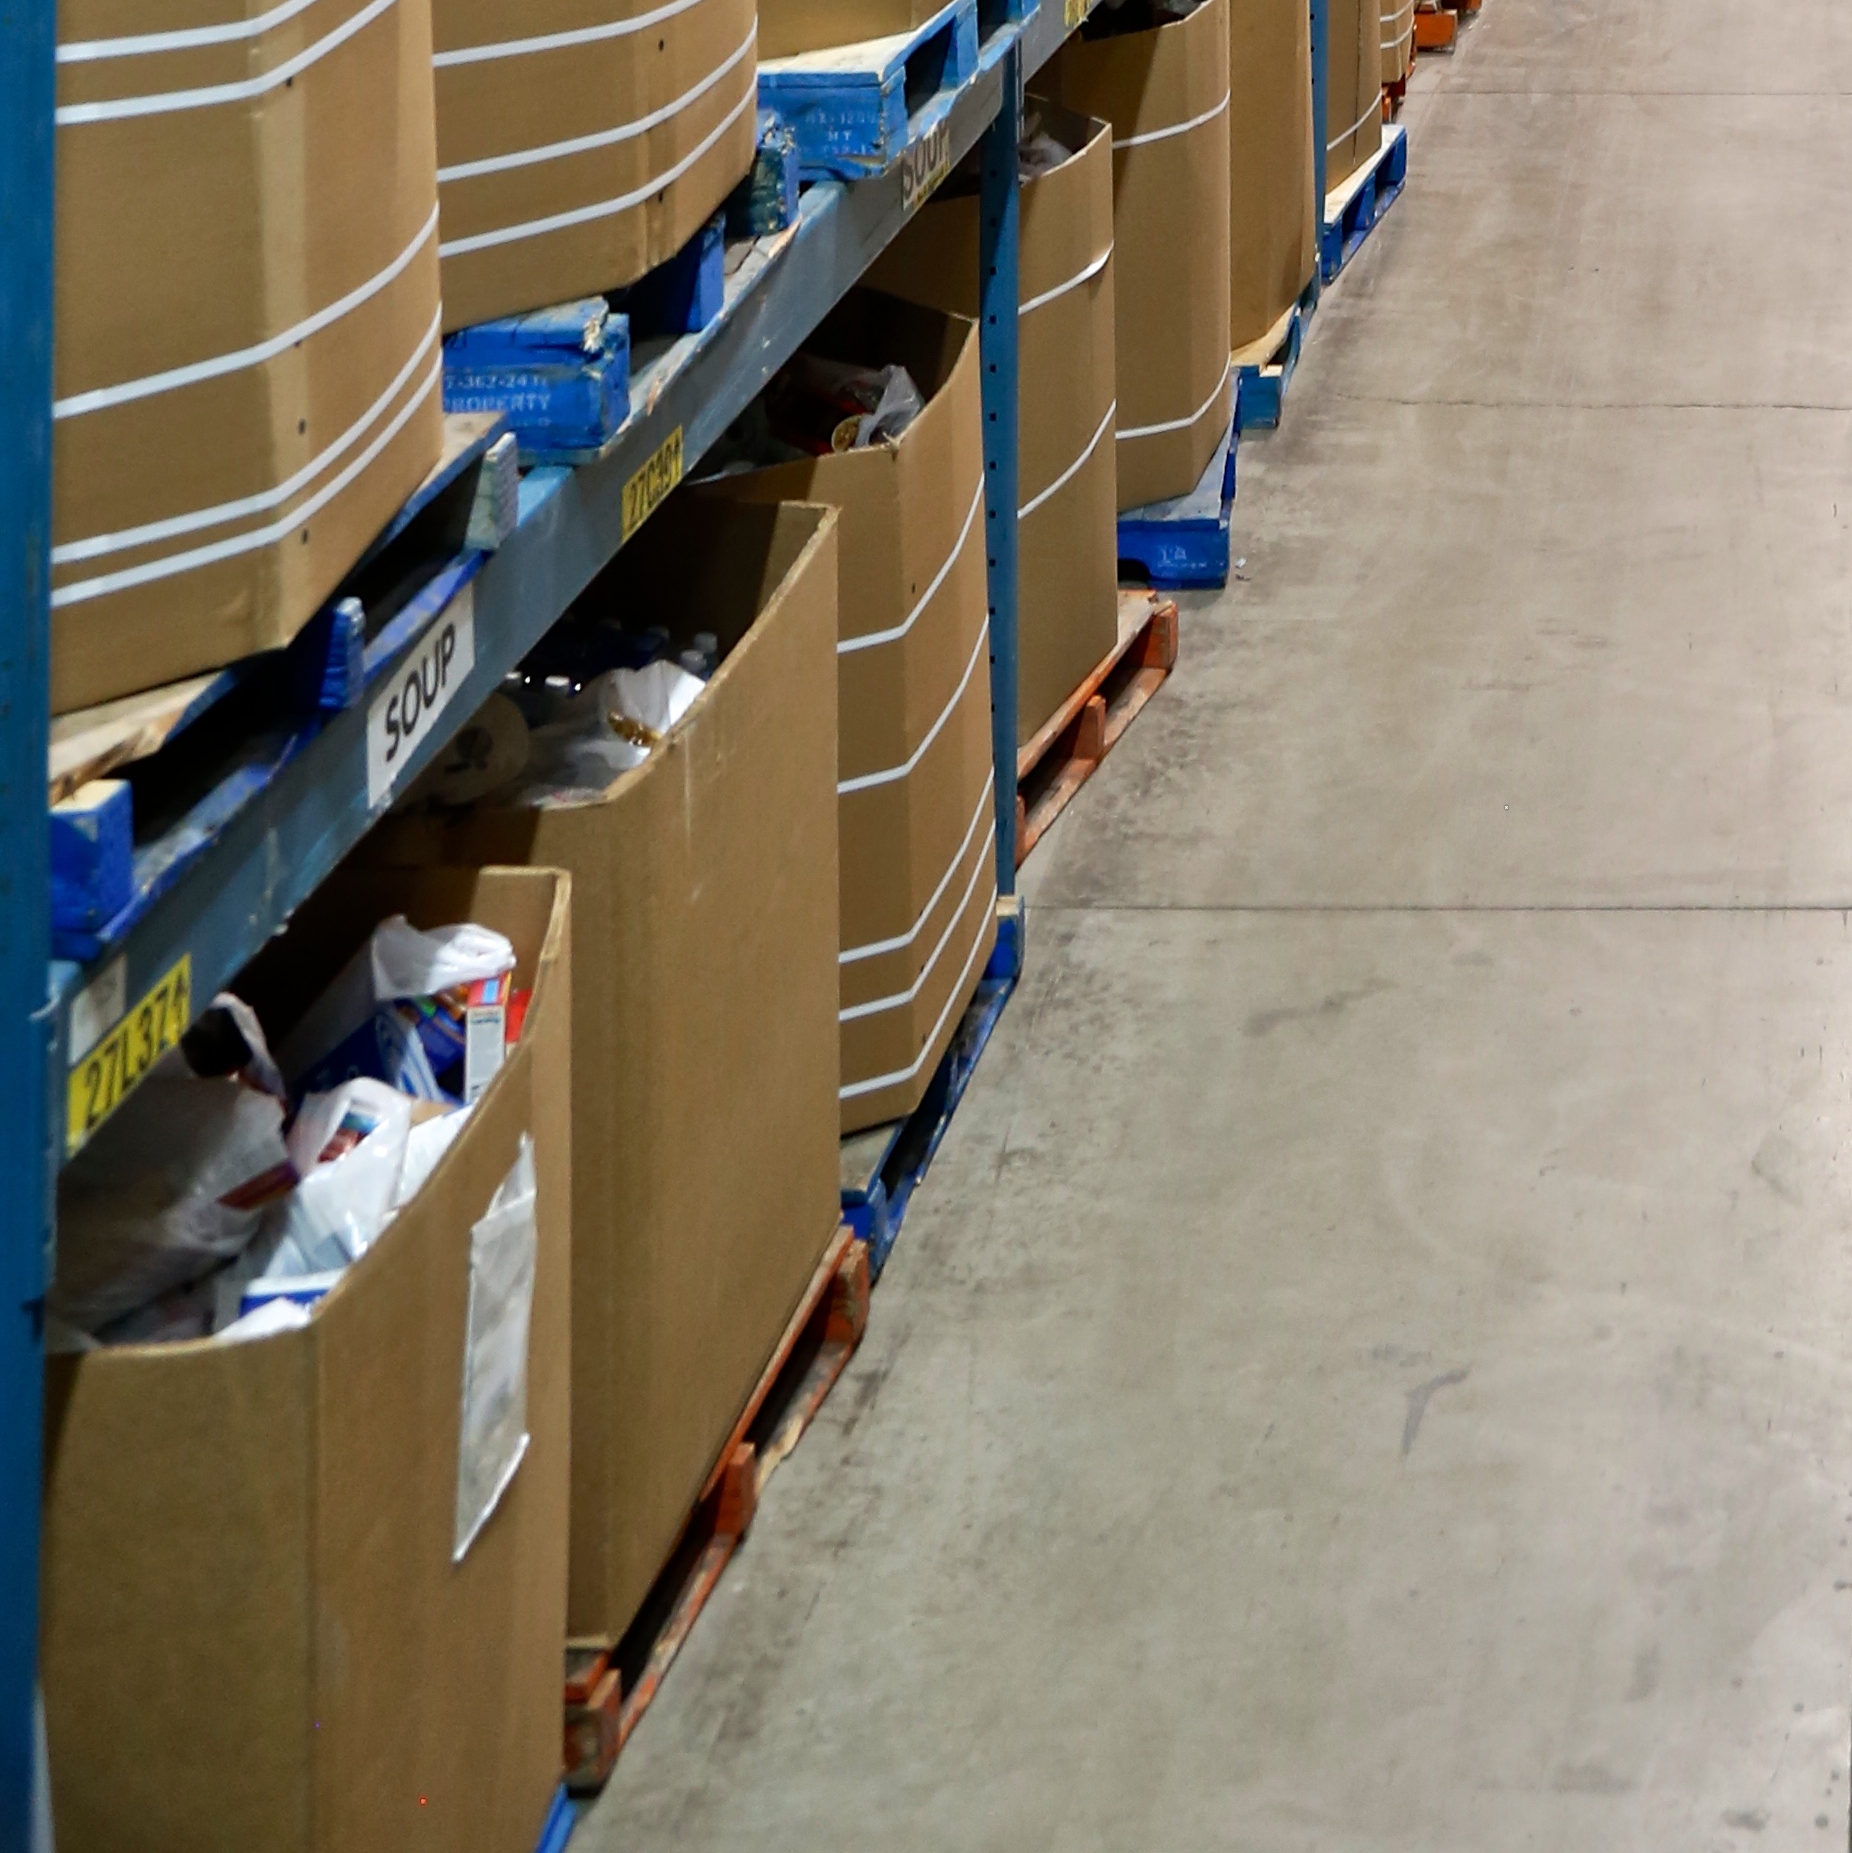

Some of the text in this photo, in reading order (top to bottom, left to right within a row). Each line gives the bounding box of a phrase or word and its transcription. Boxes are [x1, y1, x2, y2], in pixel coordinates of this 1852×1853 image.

[901, 119, 950, 201] SOUP
[385, 622, 456, 763] SOUP
[85, 984, 169, 1130] 27L37
